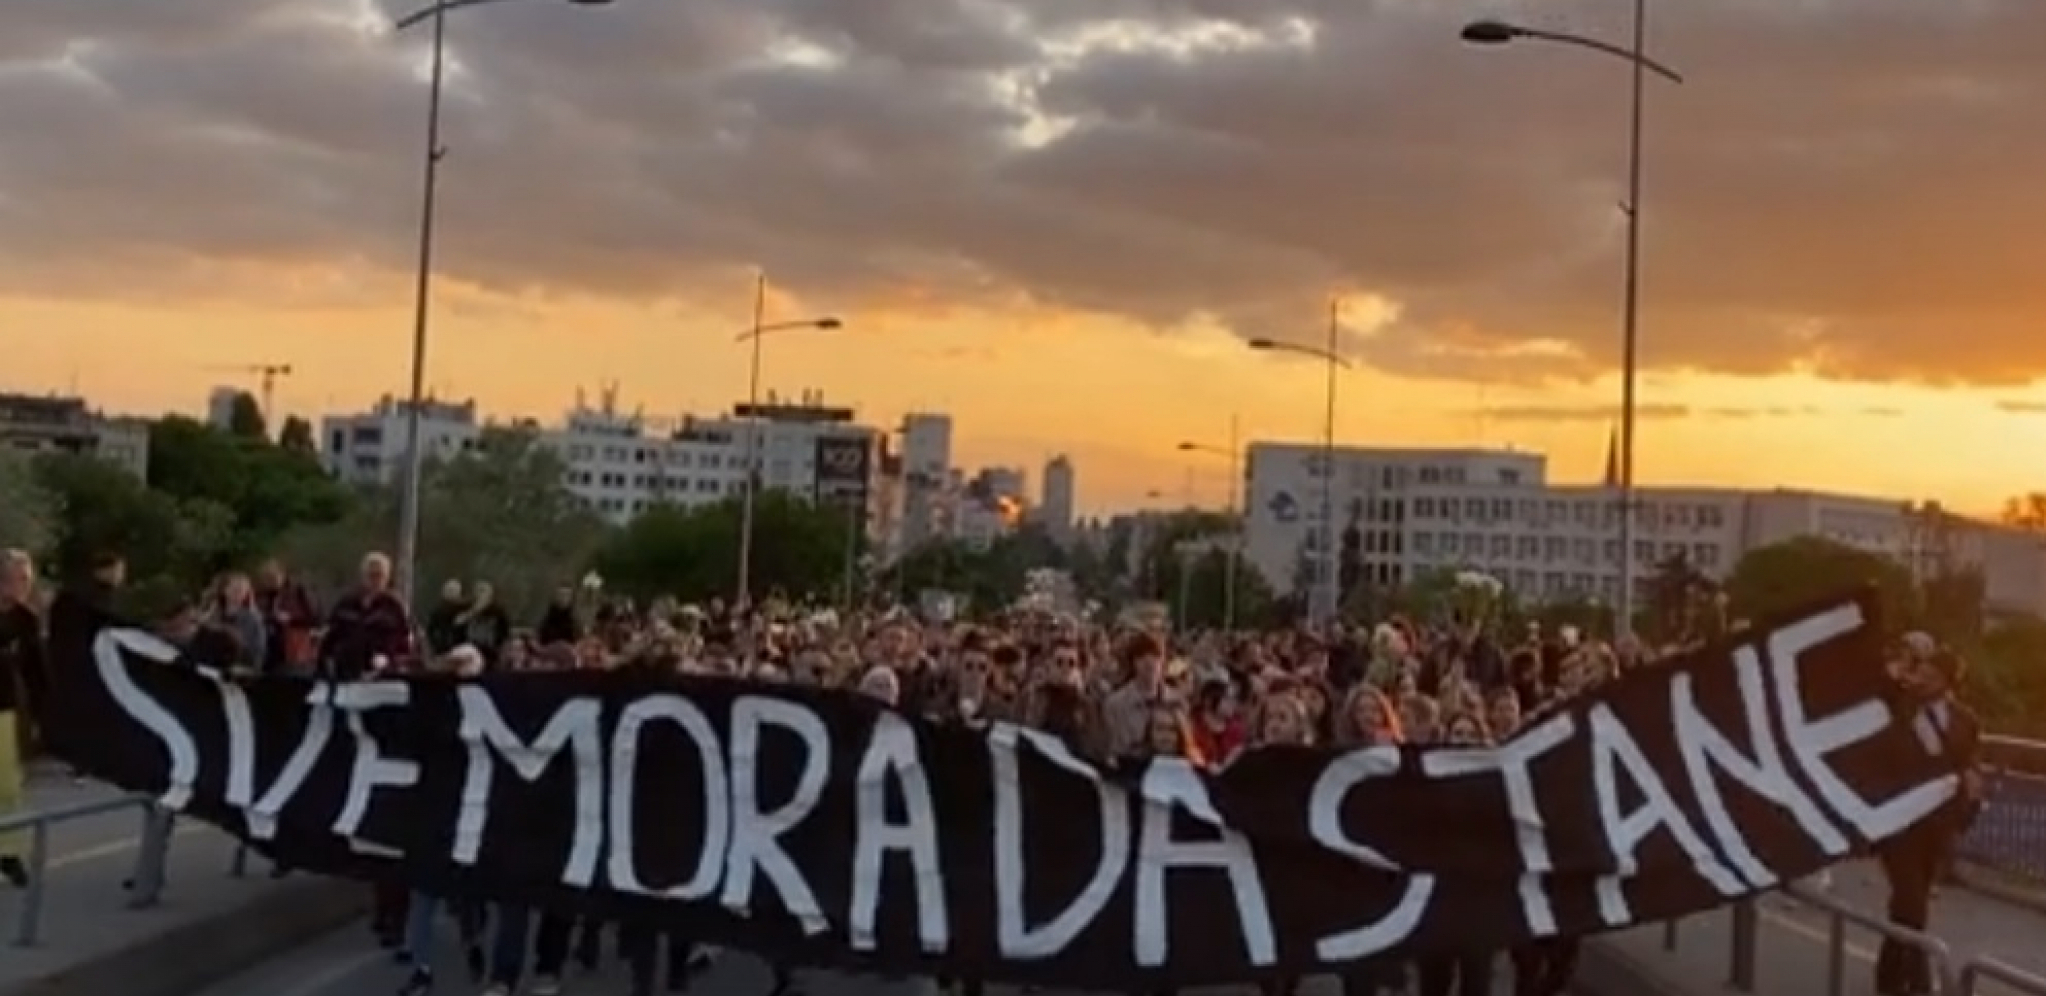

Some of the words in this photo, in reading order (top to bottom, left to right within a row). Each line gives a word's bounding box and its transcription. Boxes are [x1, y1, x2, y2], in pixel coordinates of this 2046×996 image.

[94, 626, 421, 859] SVE
[451, 682, 949, 954] MORA
[986, 720, 1277, 967] DA
[1308, 602, 1960, 962] STANE
